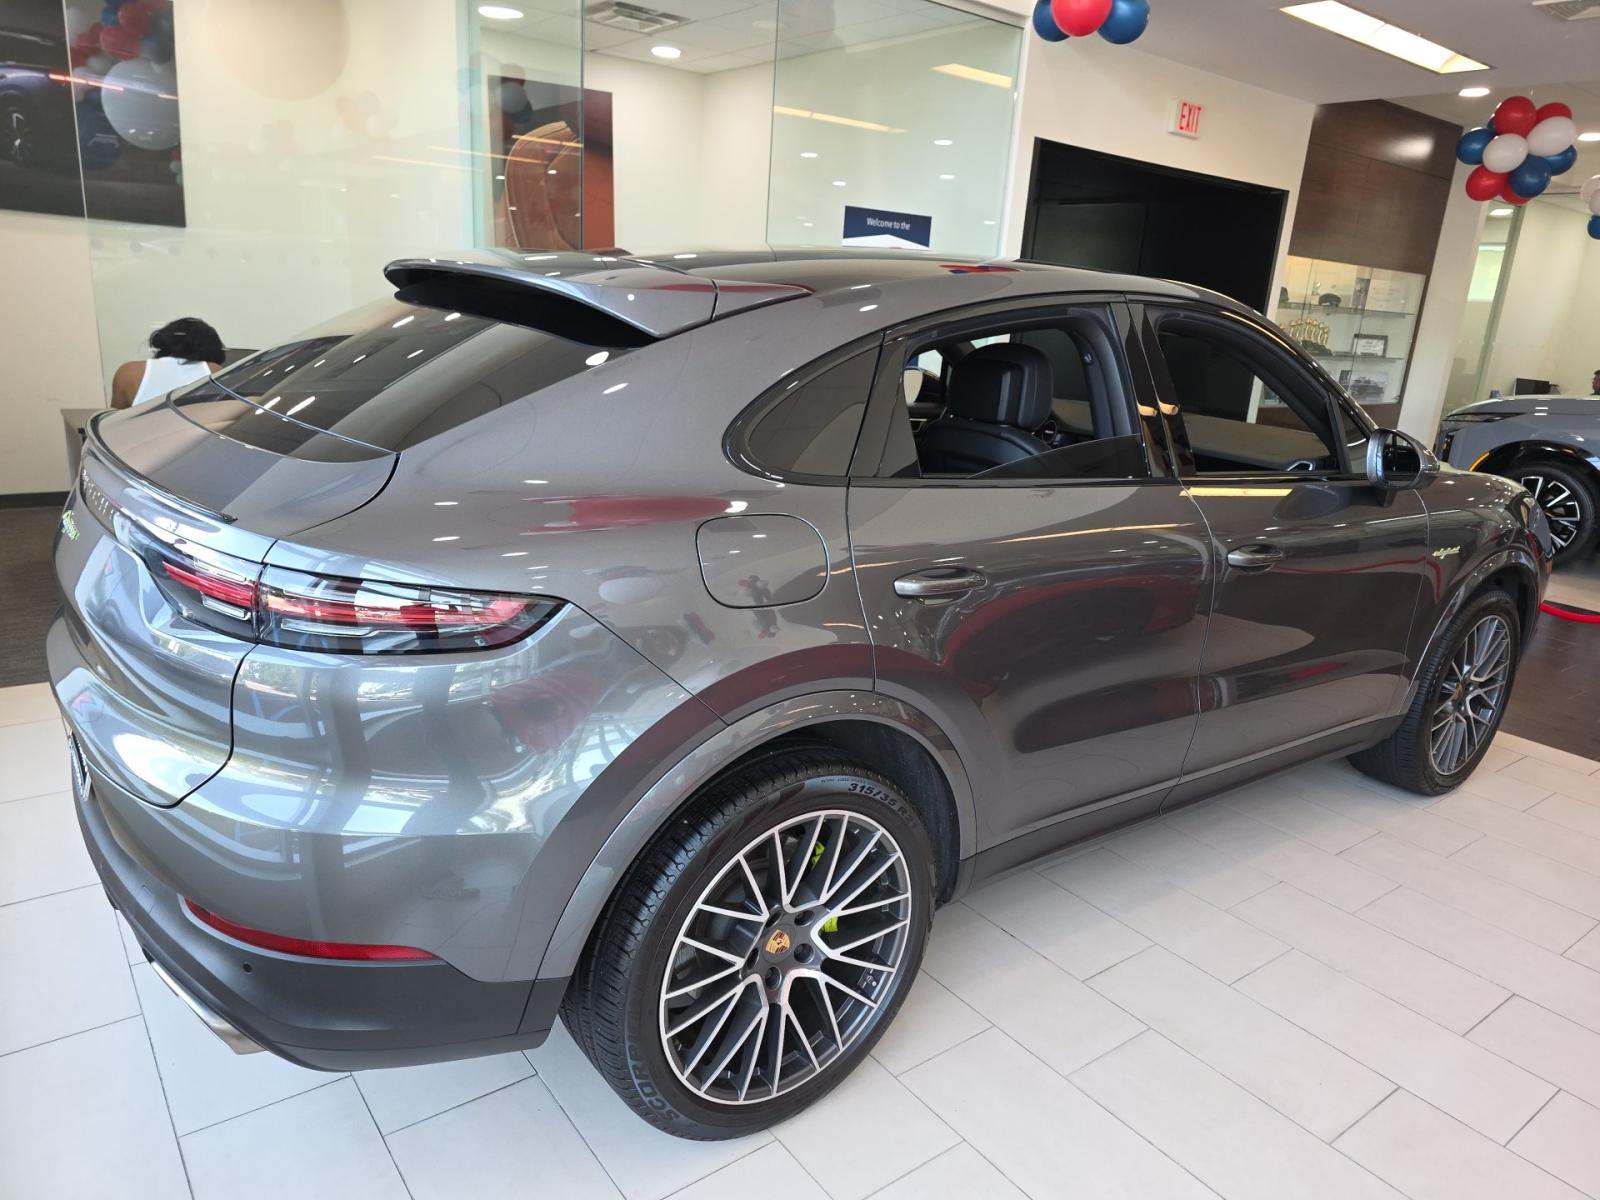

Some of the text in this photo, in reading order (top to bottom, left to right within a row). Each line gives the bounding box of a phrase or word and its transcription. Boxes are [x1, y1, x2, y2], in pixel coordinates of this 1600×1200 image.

[1178, 101, 1202, 133] EXIT
[866, 217, 911, 231] Welcome to the
[847, 782, 897, 807] 315/35
